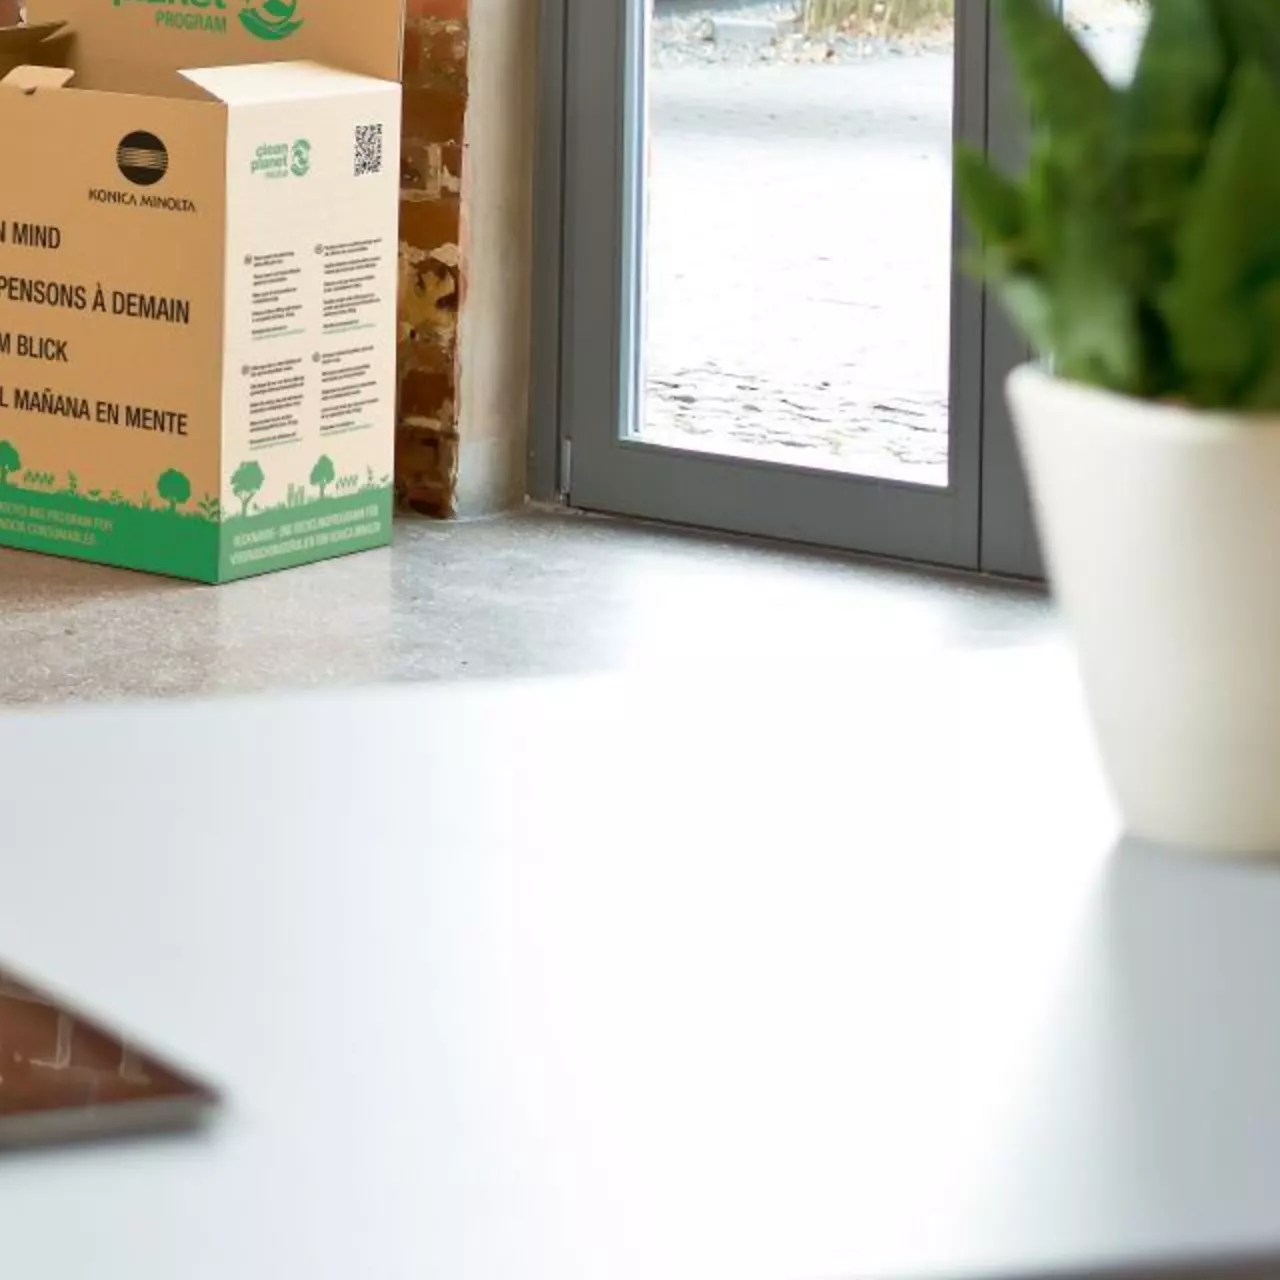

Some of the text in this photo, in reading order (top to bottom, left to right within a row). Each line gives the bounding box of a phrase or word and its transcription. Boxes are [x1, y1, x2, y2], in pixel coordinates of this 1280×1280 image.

[155, 10, 228, 34] PROGRAM
[88, 188, 196, 212] KONICA MINOLTA
[12, 224, 62, 249] MIND
[91, 282, 107, 312] À
[112, 290, 190, 324] DEMAIN
[17, 336, 69, 362] BLICK
[14, 388, 91, 421] MAÑANA
[95, 402, 119, 425] EN
[125, 406, 188, 436] MENTE
